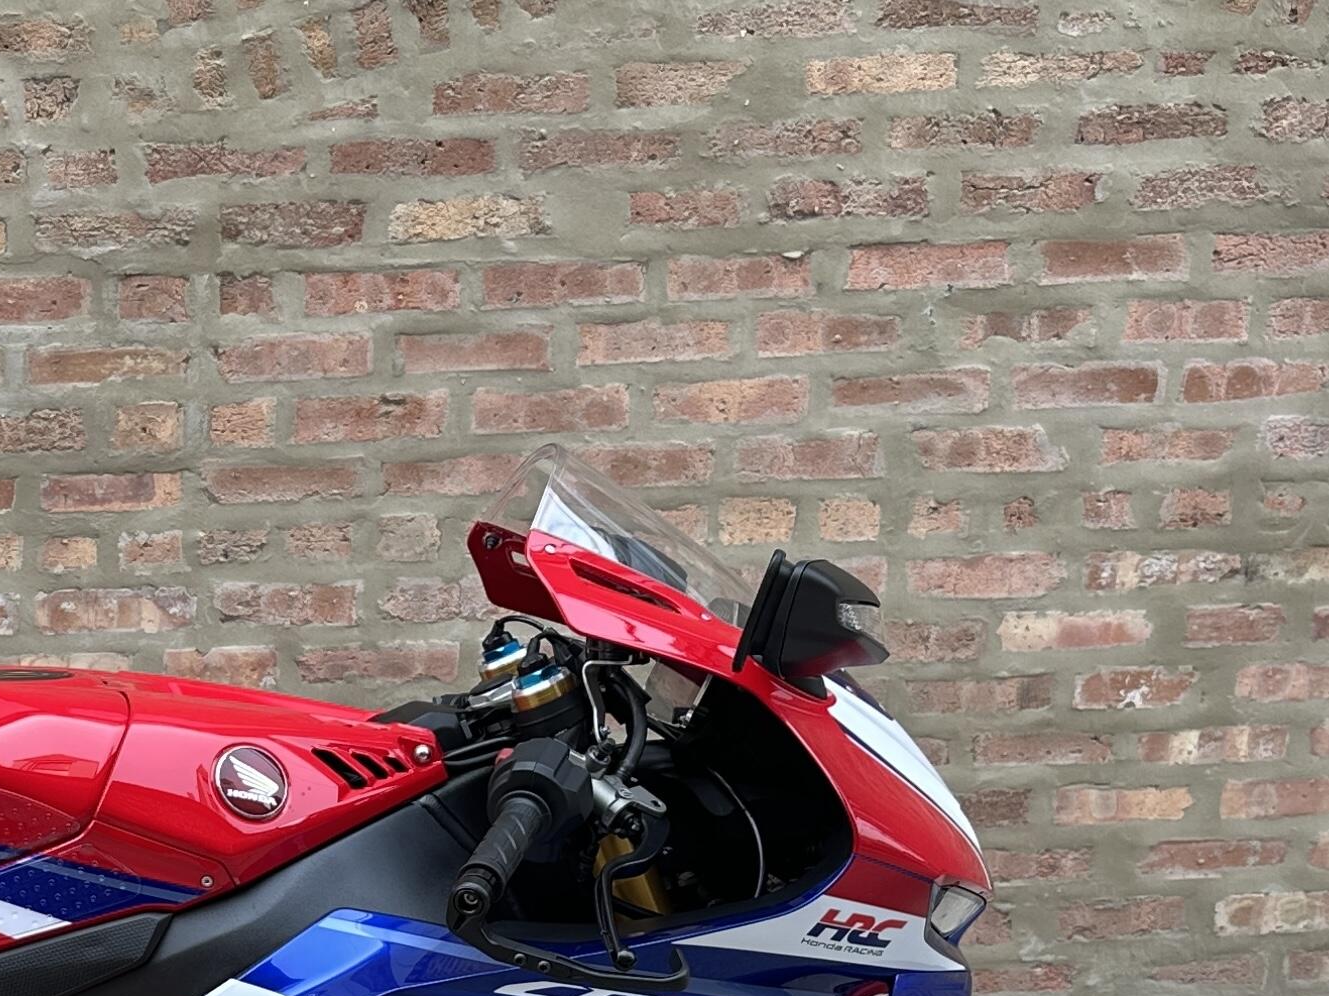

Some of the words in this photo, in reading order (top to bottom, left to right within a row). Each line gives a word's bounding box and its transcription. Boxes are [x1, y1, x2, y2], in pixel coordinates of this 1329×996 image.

[227, 788, 278, 809] HONDA
[806, 908, 908, 949] HRC
[800, 937, 842, 952] Honda
[843, 946, 885, 957] RACING
